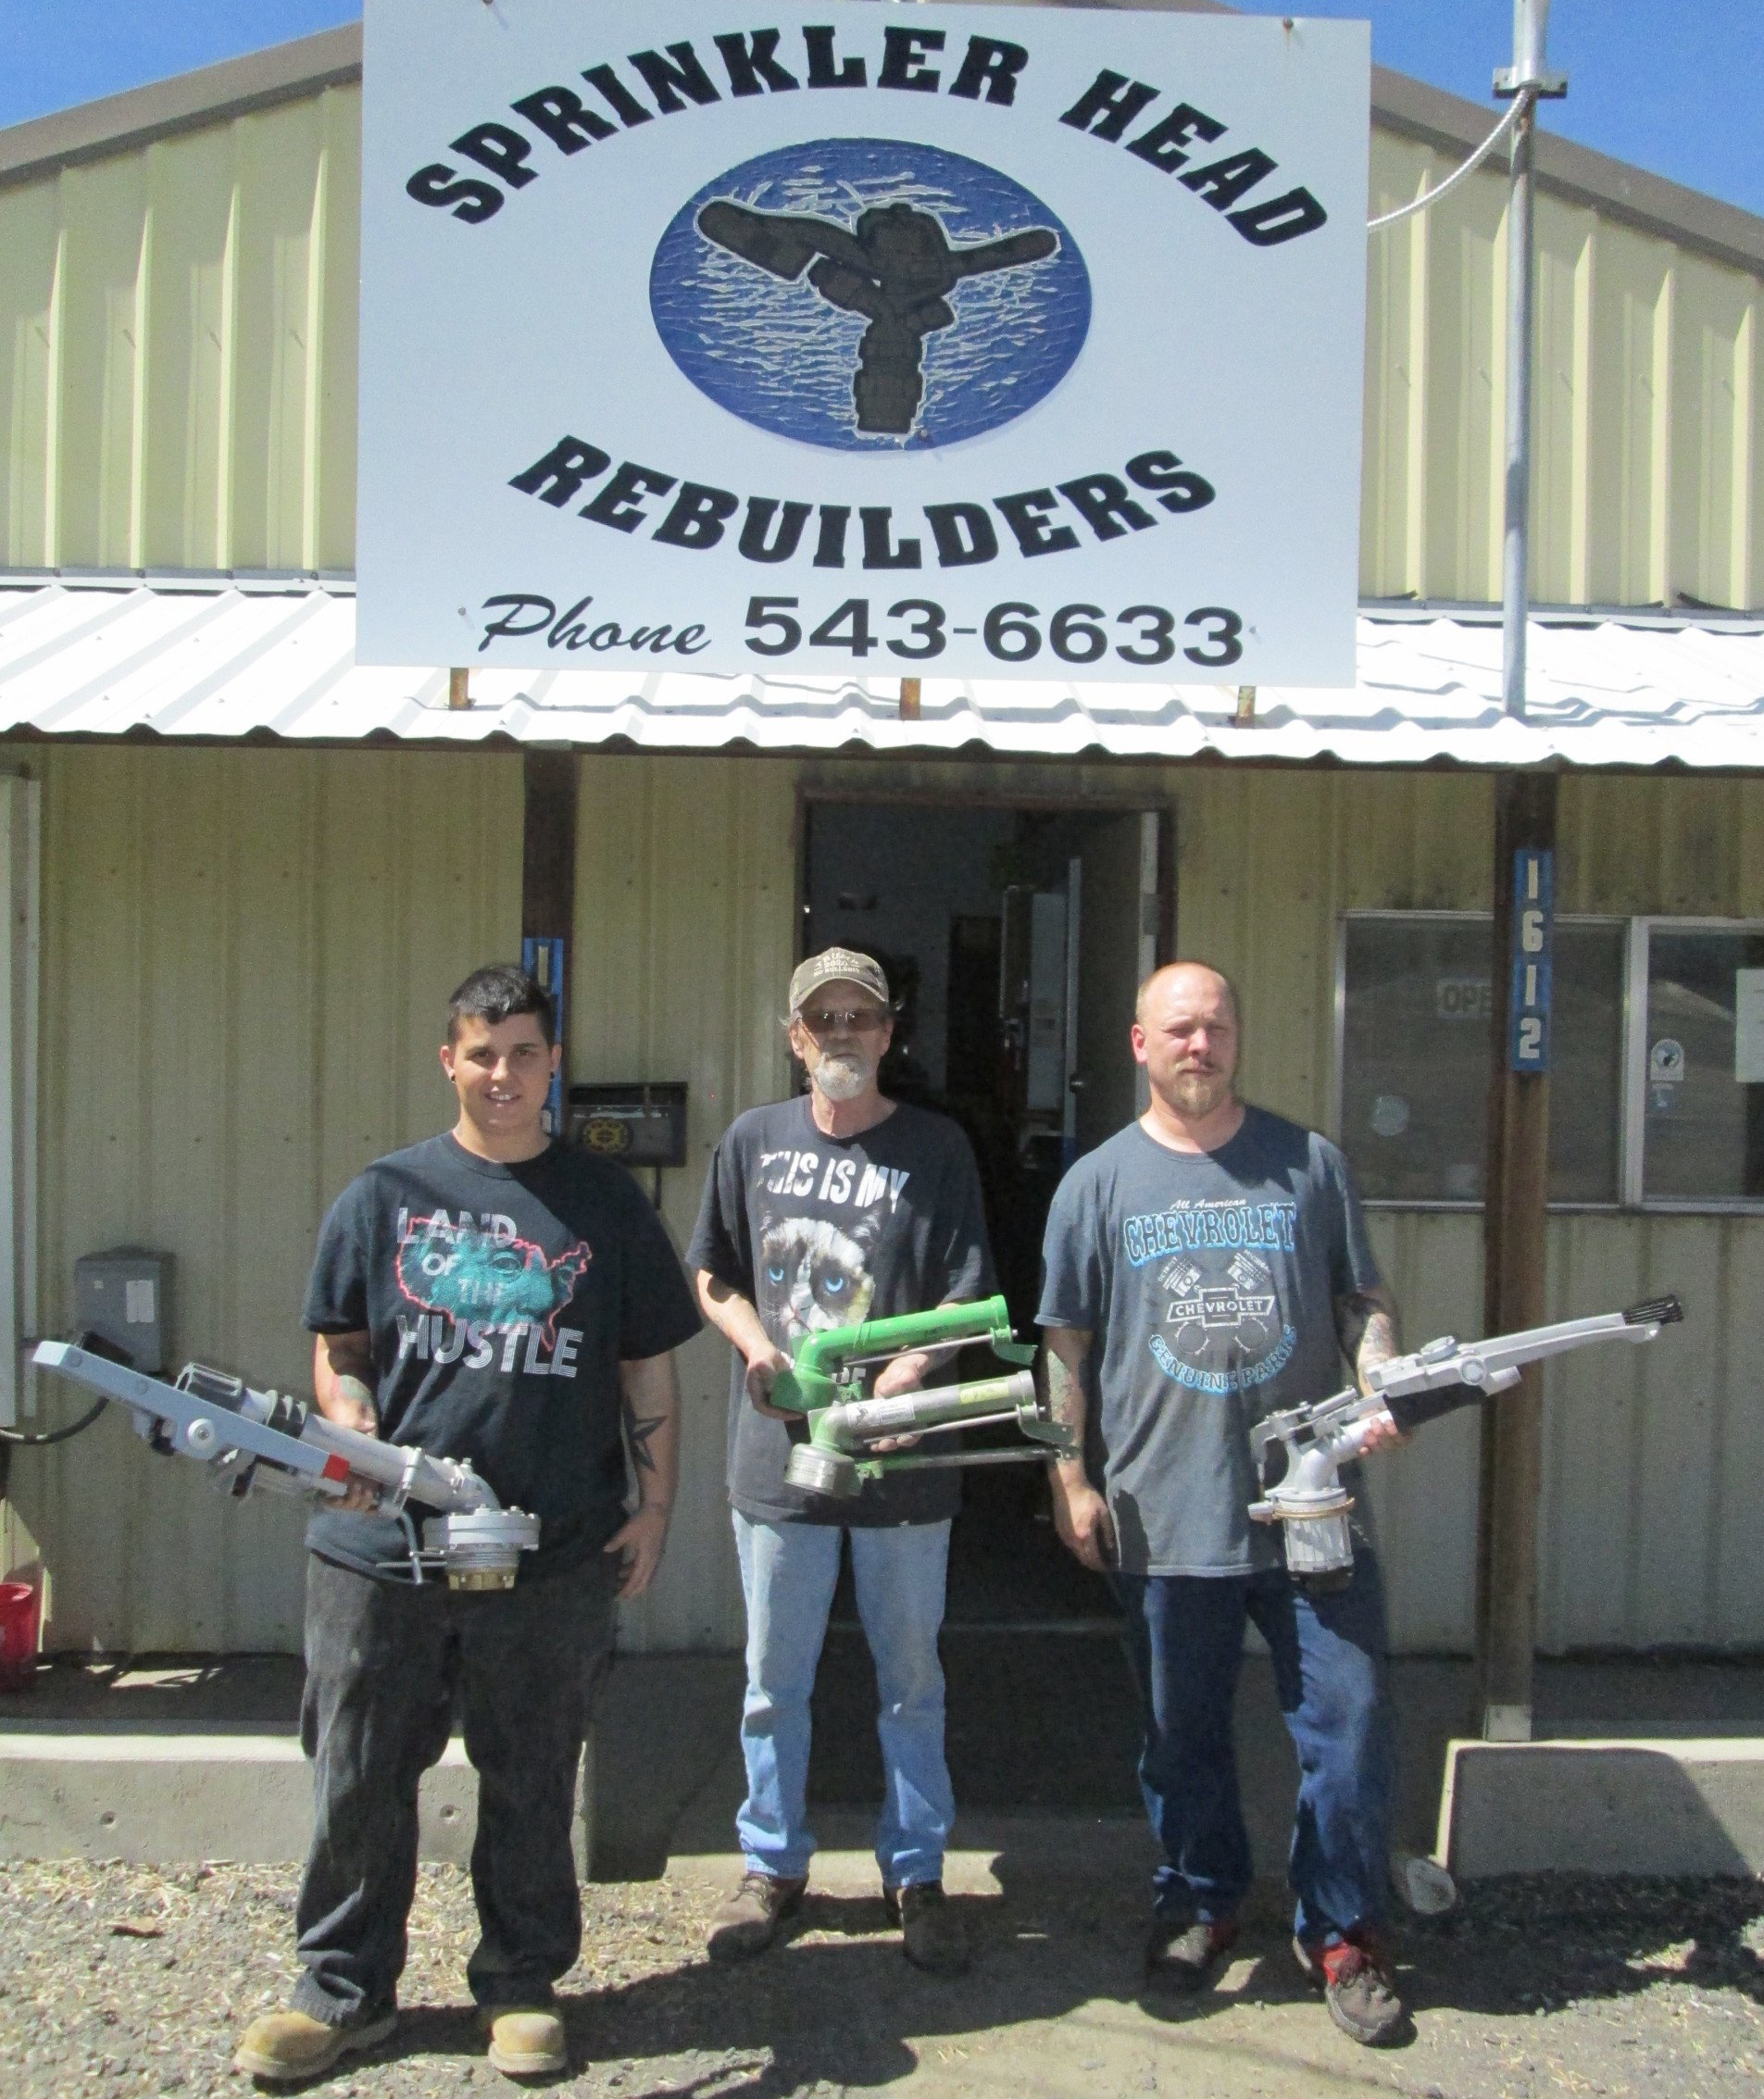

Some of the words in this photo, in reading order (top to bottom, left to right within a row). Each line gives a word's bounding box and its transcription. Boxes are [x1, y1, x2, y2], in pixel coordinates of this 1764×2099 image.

[406, 25, 1030, 225] SPRINKLER
[1059, 69, 1328, 247] HEAD
[507, 435, 1216, 570] REBUILDERS
[478, 593, 711, 655] Phone
[744, 596, 1245, 668] 543-6633
[1517, 858, 1544, 1059] 1612
[1443, 984, 1493, 1012] OPE
[818, 1157, 857, 1205] IS
[854, 1163, 910, 1214] MY
[1169, 1198, 1192, 1211] All
[1193, 1198, 1247, 1210] American
[396, 1207, 518, 1249] LAND
[1123, 1201, 1296, 1268] CHEVROLET
[421, 1253, 460, 1277] OF
[1174, 1299, 1264, 1317] CHEVROLET
[395, 1314, 585, 1379] HUSTLE
[1147, 1333, 1239, 1396] GENUINE
